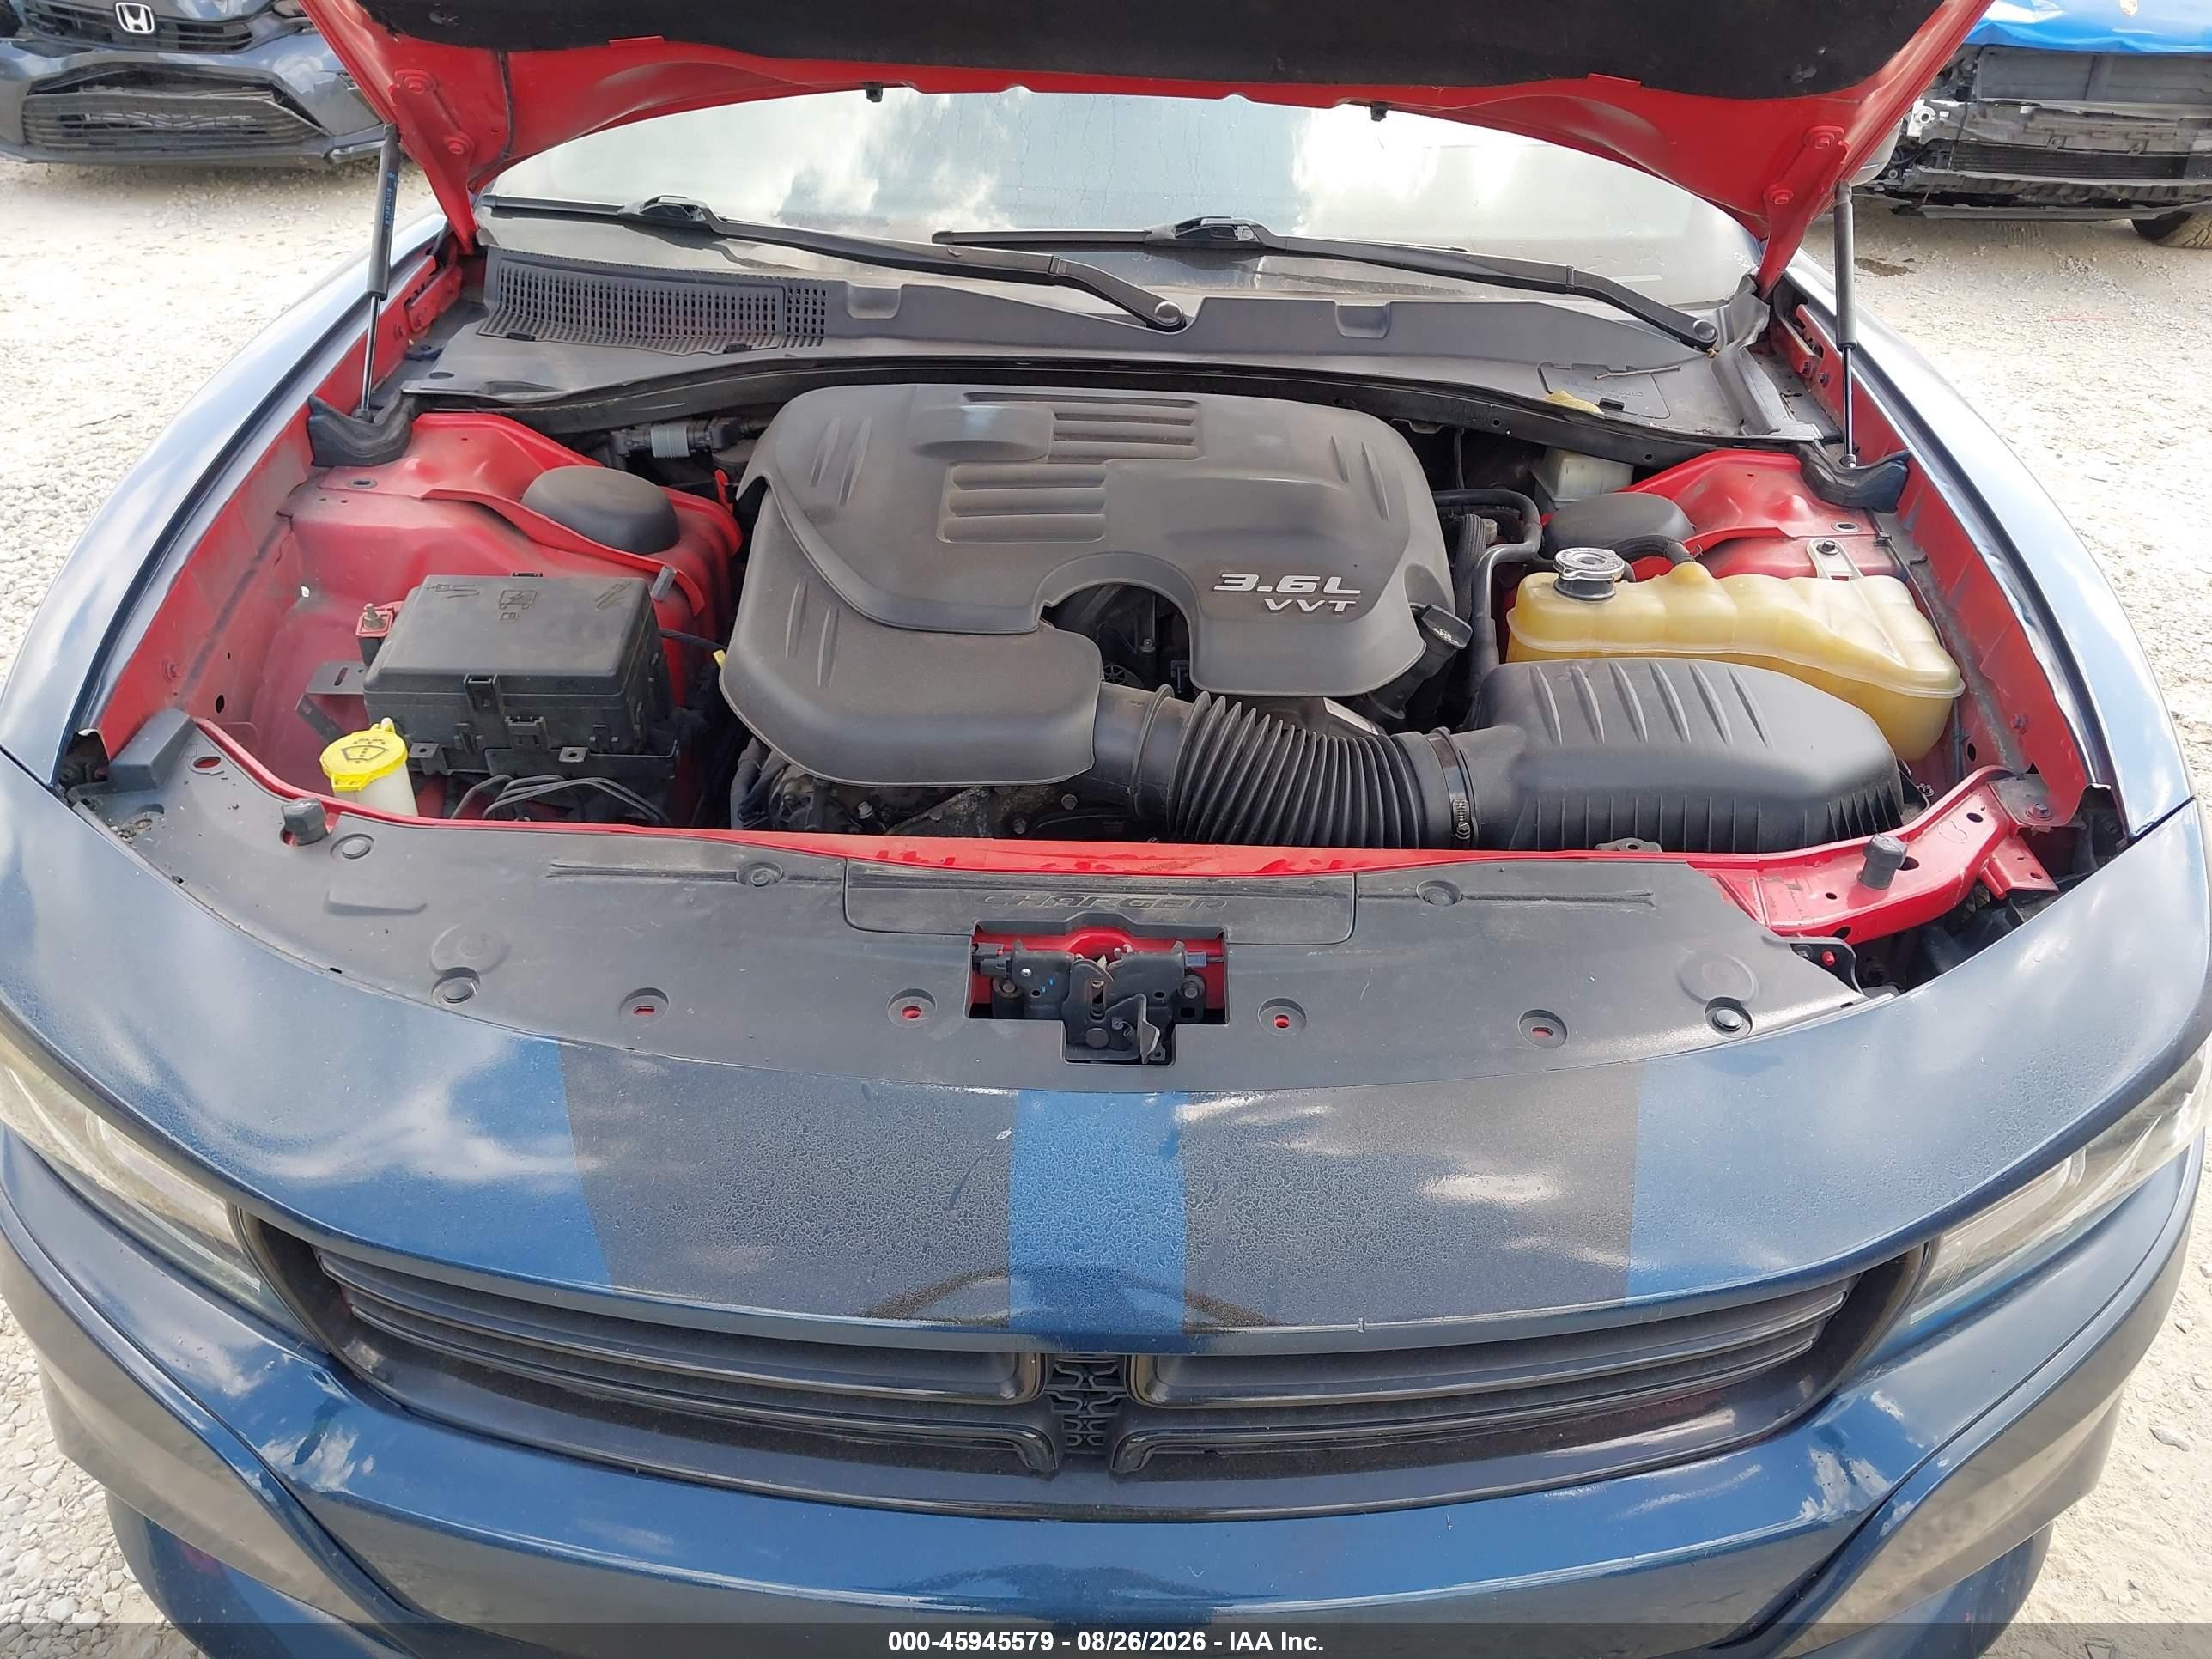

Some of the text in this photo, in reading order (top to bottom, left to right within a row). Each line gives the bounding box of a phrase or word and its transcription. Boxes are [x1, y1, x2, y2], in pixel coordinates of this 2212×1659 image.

[1212, 573, 1361, 594] 3.6L
[1264, 599, 1357, 612] VVT
[983, 894, 1228, 911] CHARGER
